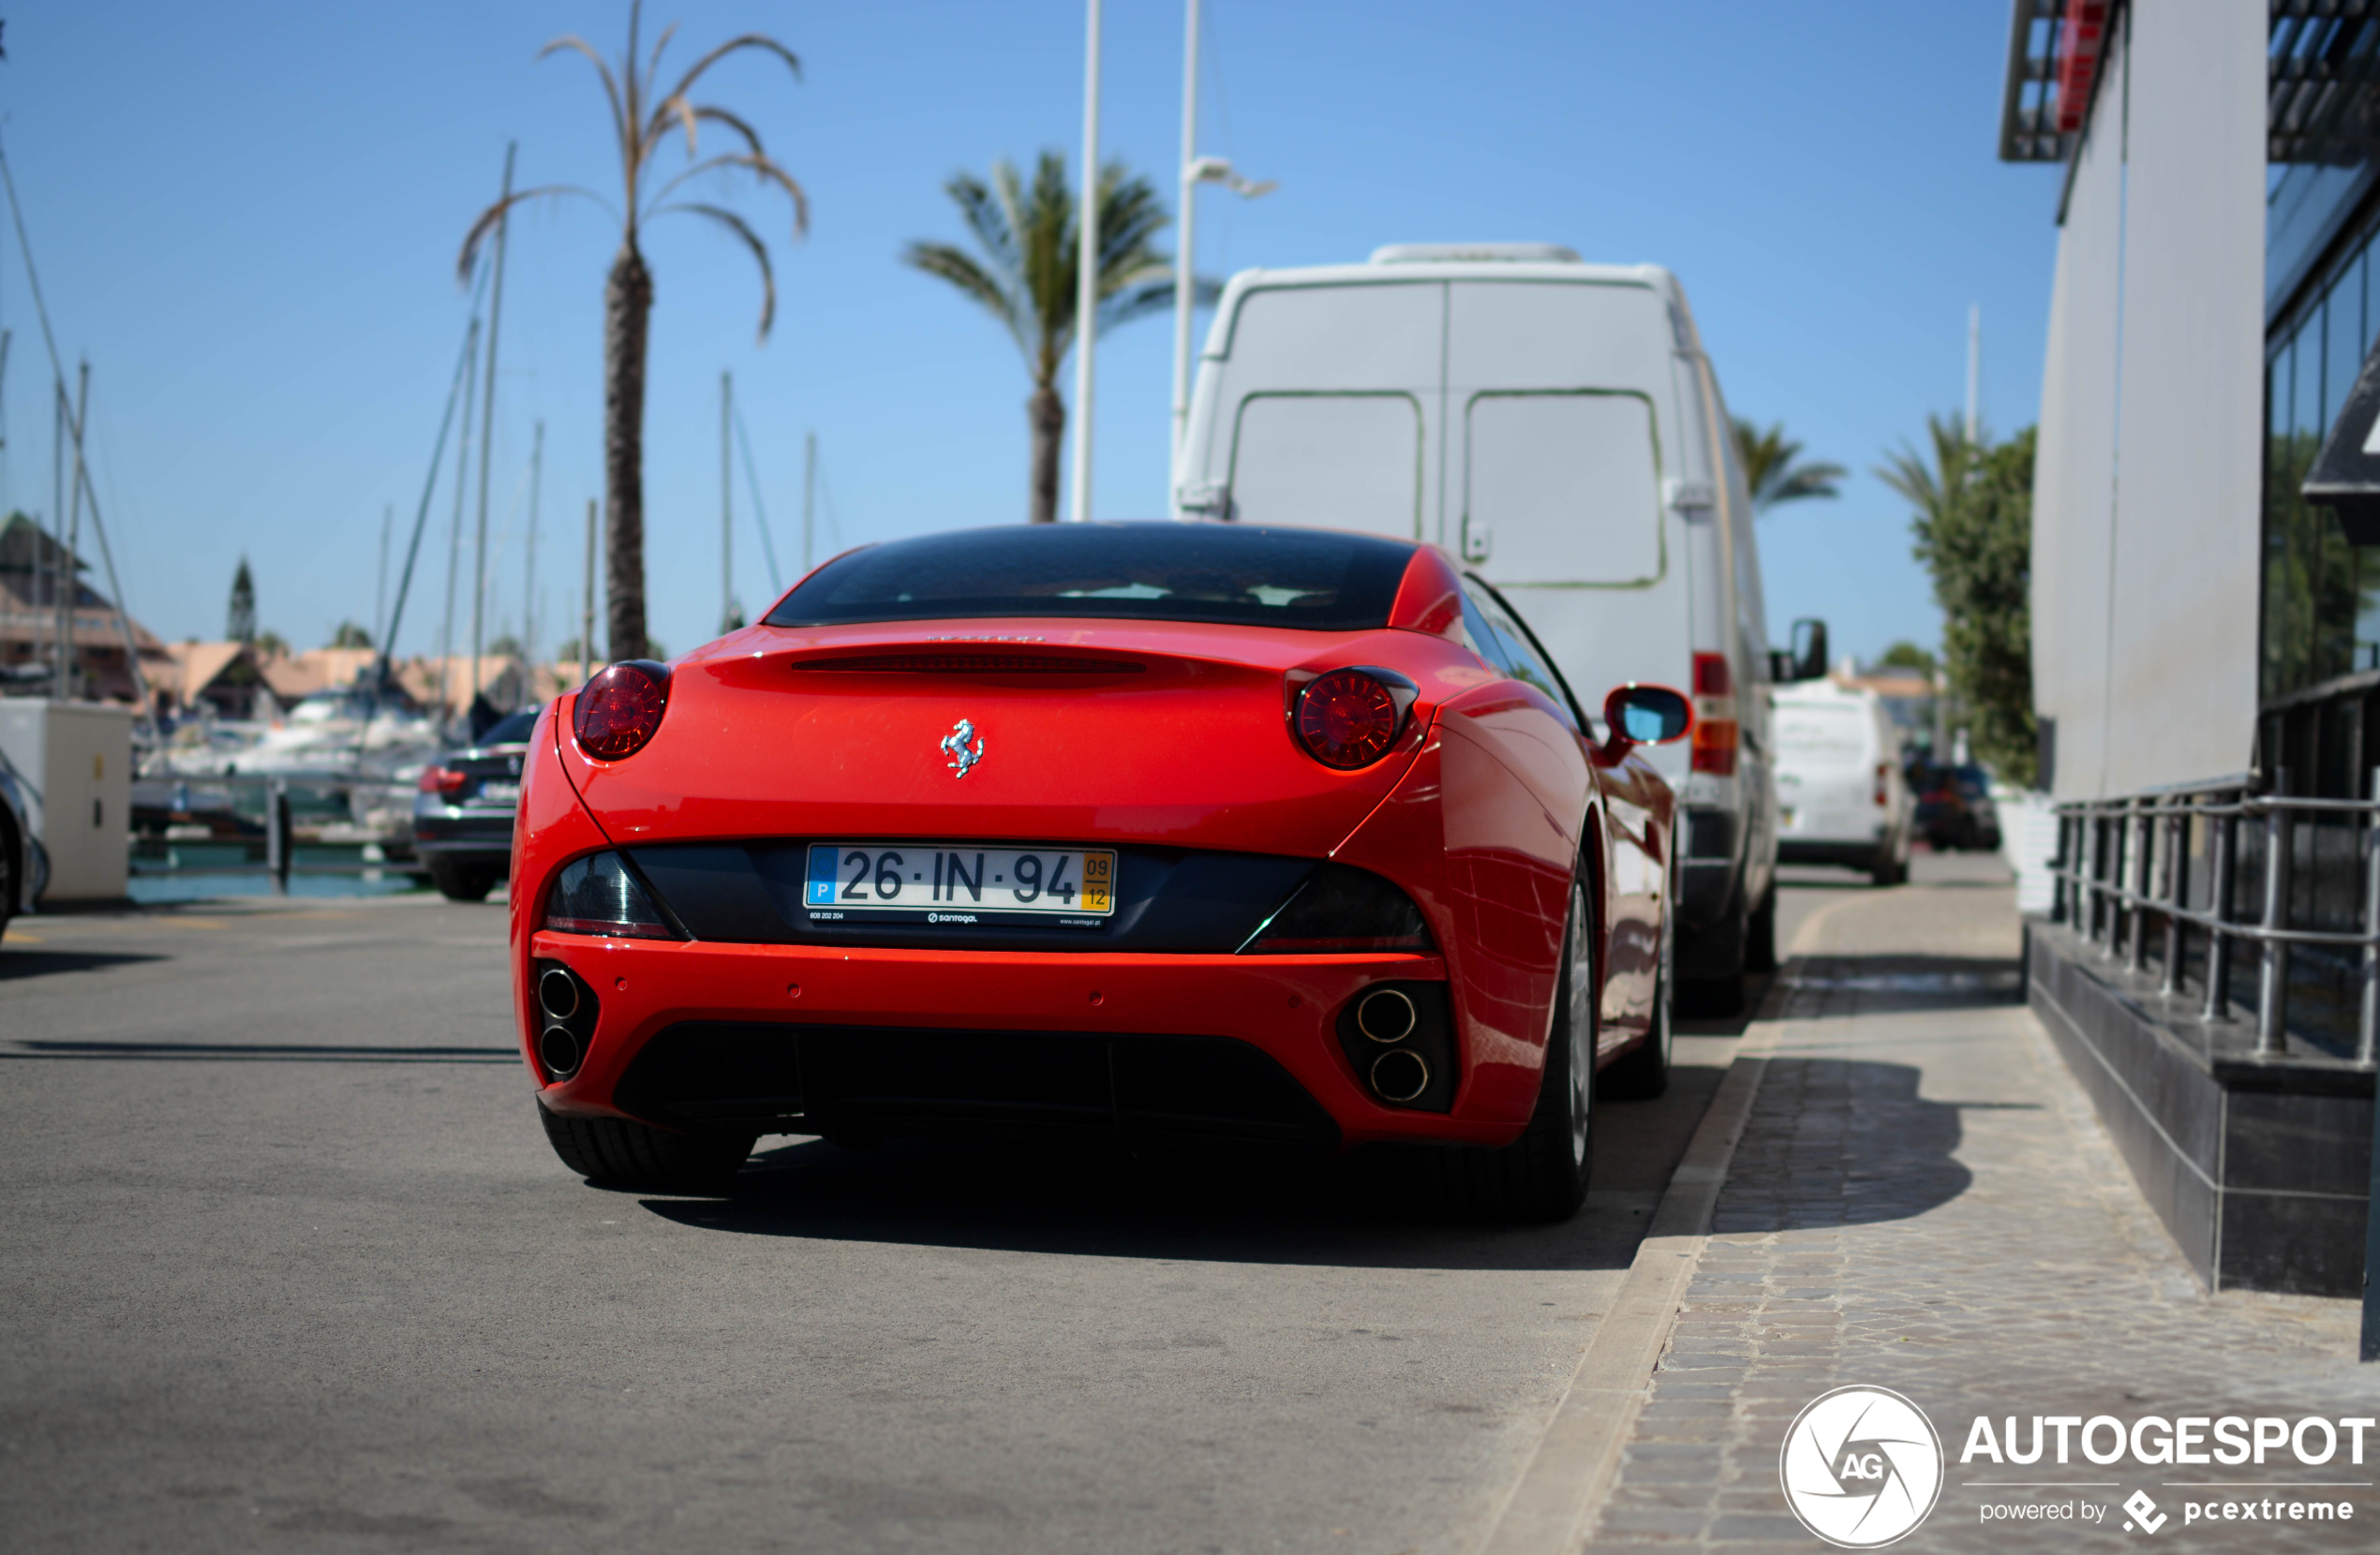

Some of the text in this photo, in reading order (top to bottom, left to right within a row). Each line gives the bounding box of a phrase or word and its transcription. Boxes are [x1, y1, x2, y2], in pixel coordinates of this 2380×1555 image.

[1087, 859, 1108, 876] 09
[817, 884, 828, 897] P
[1089, 888, 1106, 905] 12
